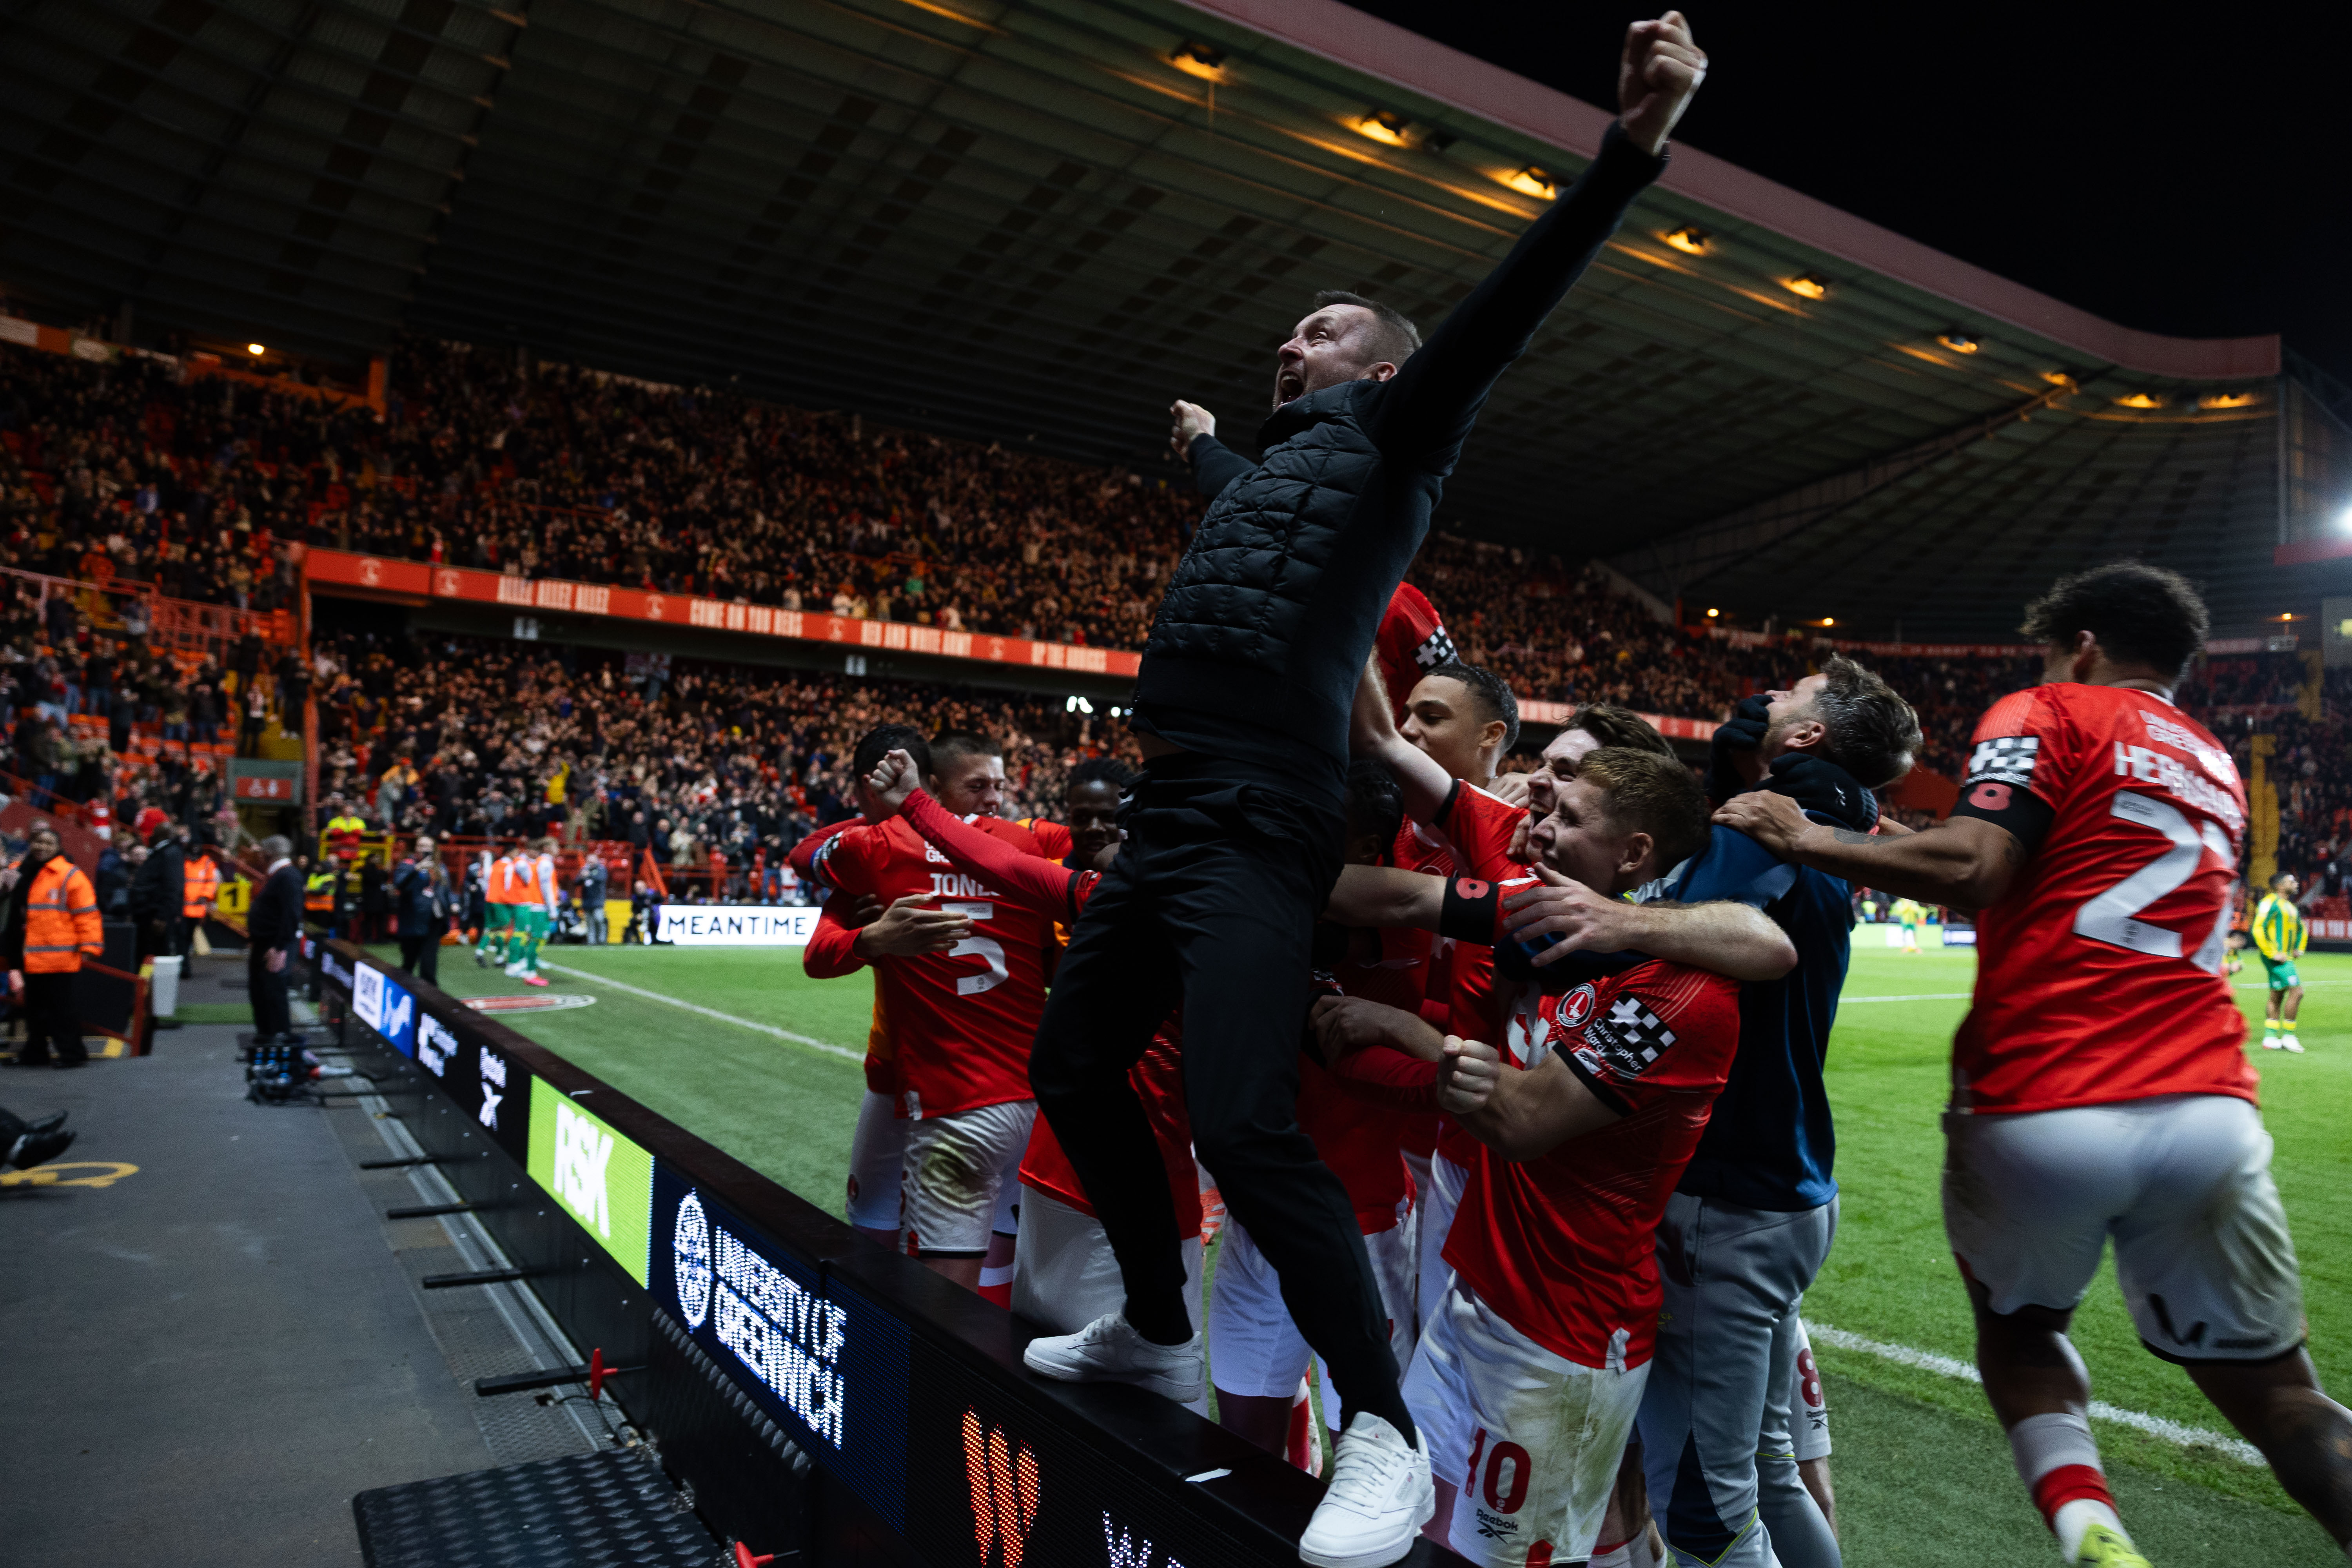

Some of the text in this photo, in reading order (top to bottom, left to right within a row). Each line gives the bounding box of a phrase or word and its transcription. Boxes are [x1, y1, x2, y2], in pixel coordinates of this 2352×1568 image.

[929, 873, 1001, 897] JON
[668, 916, 806, 935] MEANTIME
[1584, 1025, 1607, 1053] Ward
[1594, 1018, 1644, 1071] Christopher
[553, 1101, 614, 1239] RSK
[715, 1225, 847, 1364] UNIVERSITY OF
[714, 1280, 844, 1450] GREENWICH
[1797, 1348, 1822, 1408] 8
[1465, 1426, 1532, 1514] 10
[1476, 1508, 1518, 1531] Reebok
